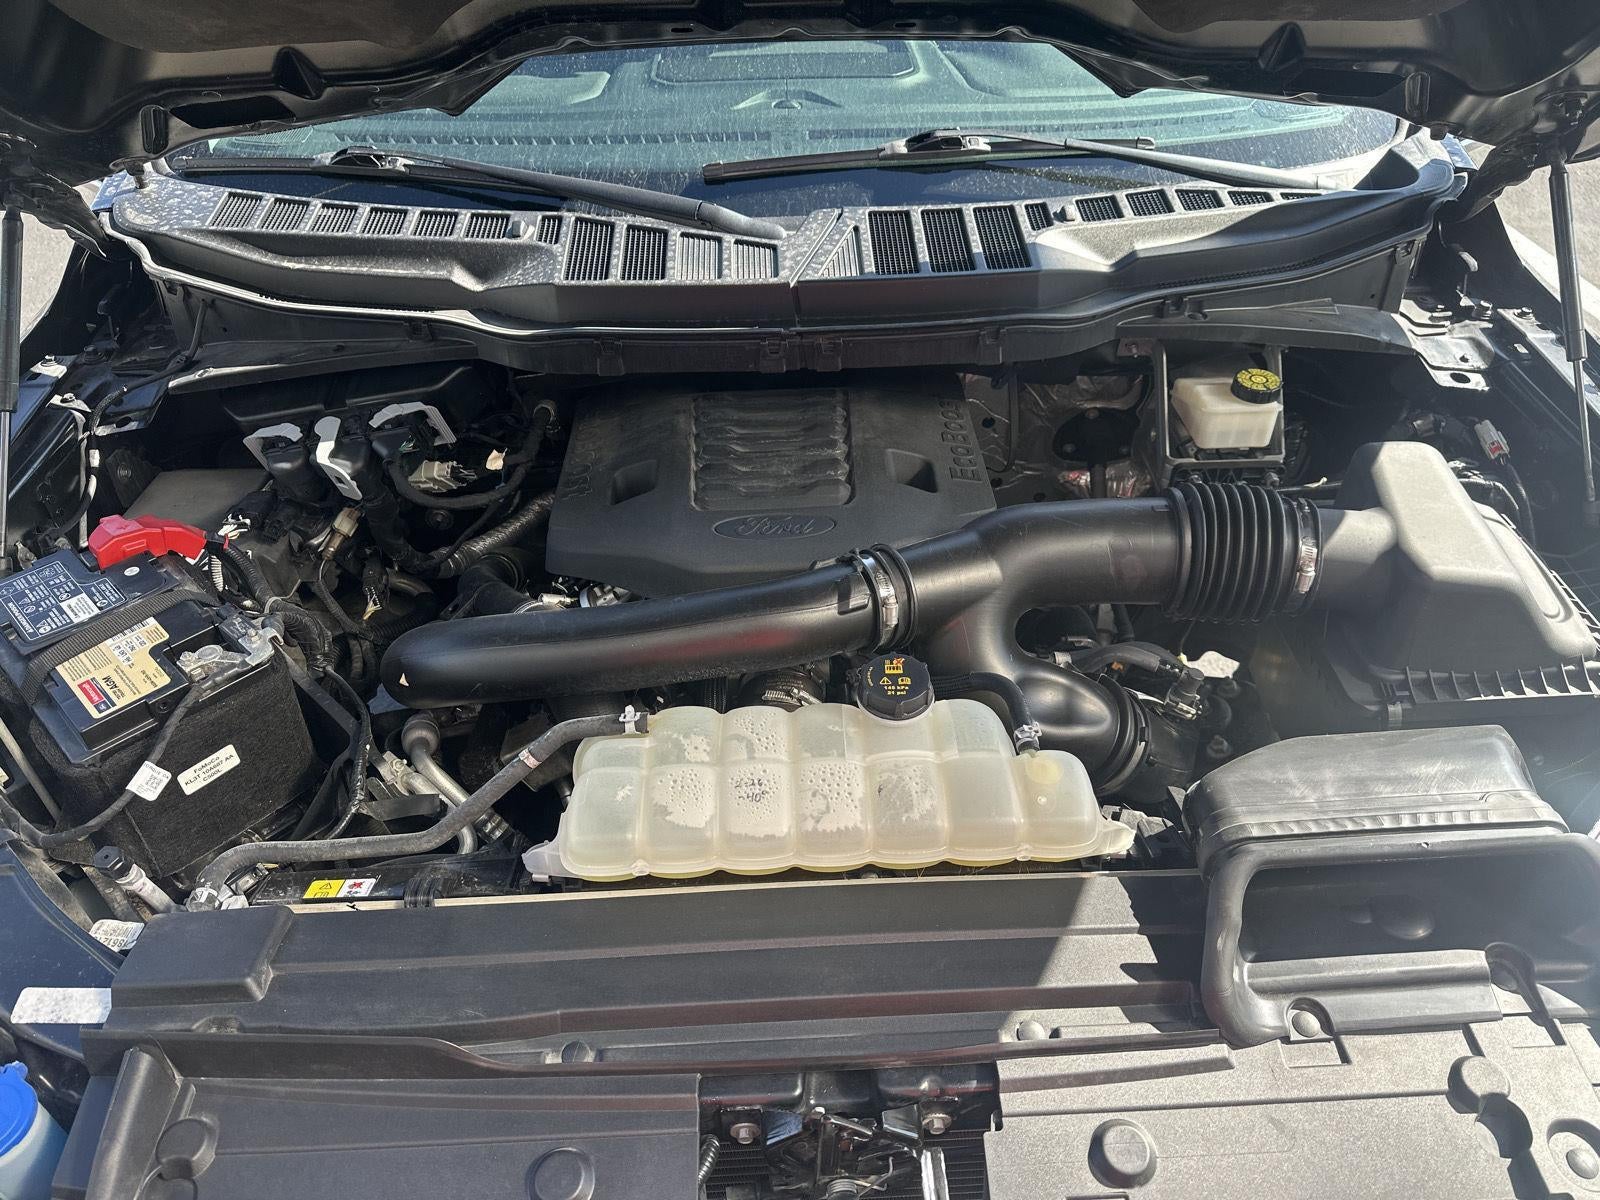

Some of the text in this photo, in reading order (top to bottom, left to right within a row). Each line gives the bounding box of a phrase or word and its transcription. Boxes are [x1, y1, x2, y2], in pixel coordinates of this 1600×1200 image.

[938, 398, 983, 483] EcoBoos
[737, 515, 816, 536] Ford
[101, 674, 119, 691] AGM
[194, 757, 220, 773] FoMoCo
[225, 754, 234, 762] AA
